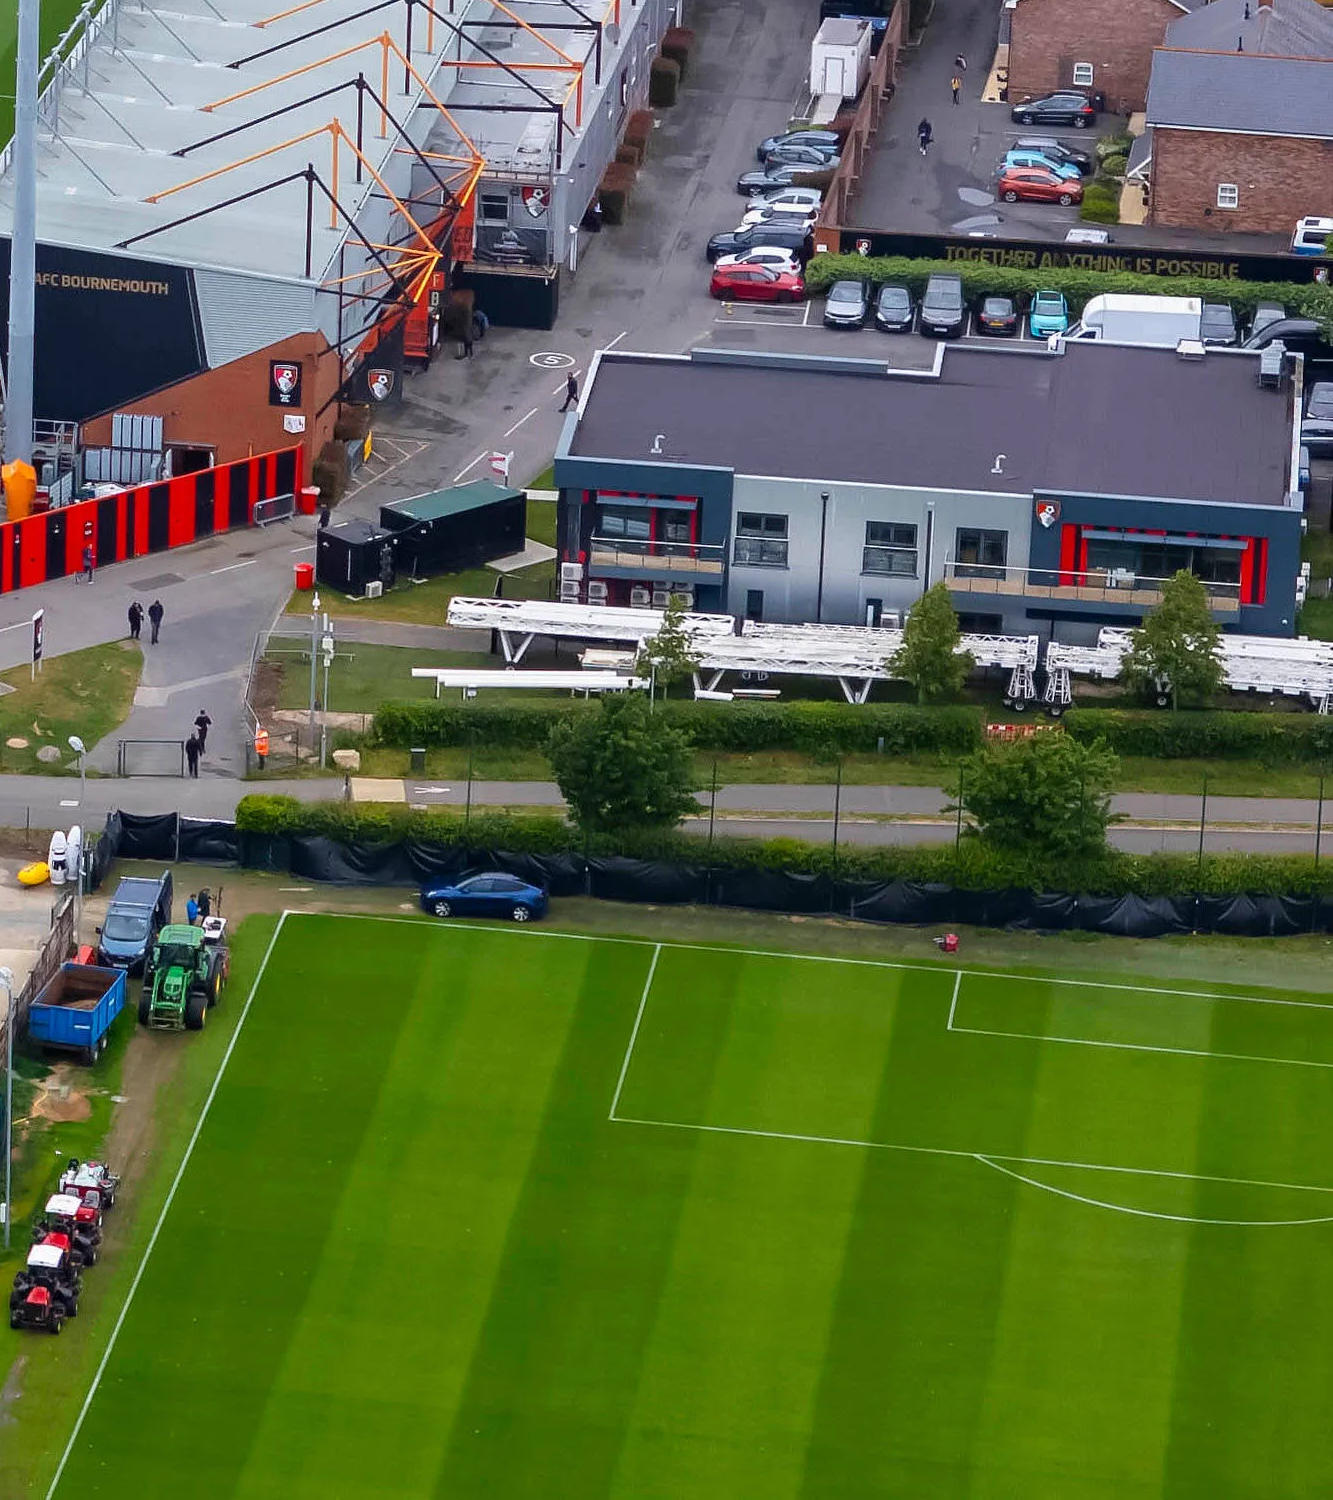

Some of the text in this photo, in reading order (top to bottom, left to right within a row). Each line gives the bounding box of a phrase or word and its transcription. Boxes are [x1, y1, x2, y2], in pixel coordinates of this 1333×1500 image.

[945, 245, 1037, 267] TOGETHER
[1136, 257, 1152, 273] IS
[1156, 259, 1240, 280] POSSIBLE
[35, 272, 169, 296] AFC BOURNEMOUTH
